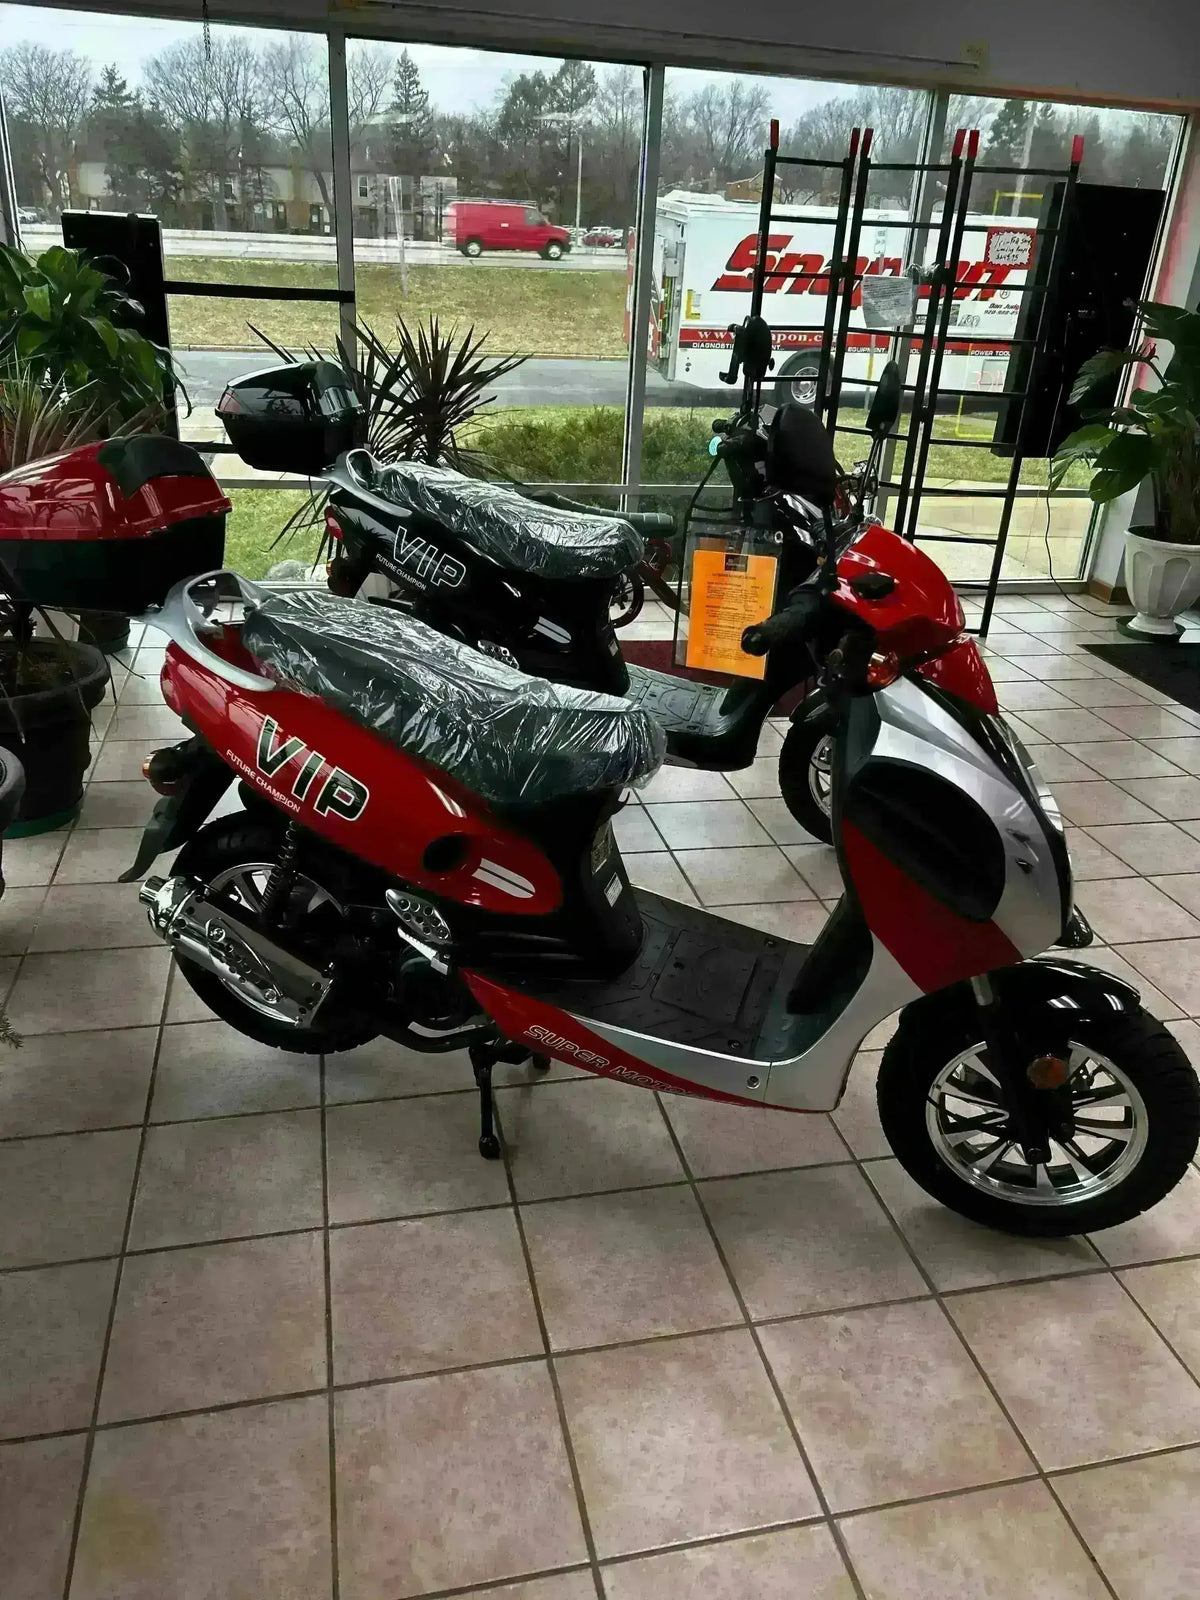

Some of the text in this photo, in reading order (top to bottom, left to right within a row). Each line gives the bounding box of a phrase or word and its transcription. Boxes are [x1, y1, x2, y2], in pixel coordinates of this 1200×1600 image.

[375, 553, 427, 590] FUTURE CHAMPION
[393, 525, 467, 588] VIP
[226, 749, 301, 813] FUTURE CHAMPION
[256, 714, 370, 822] VIP
[523, 1024, 610, 1069] SUPER
